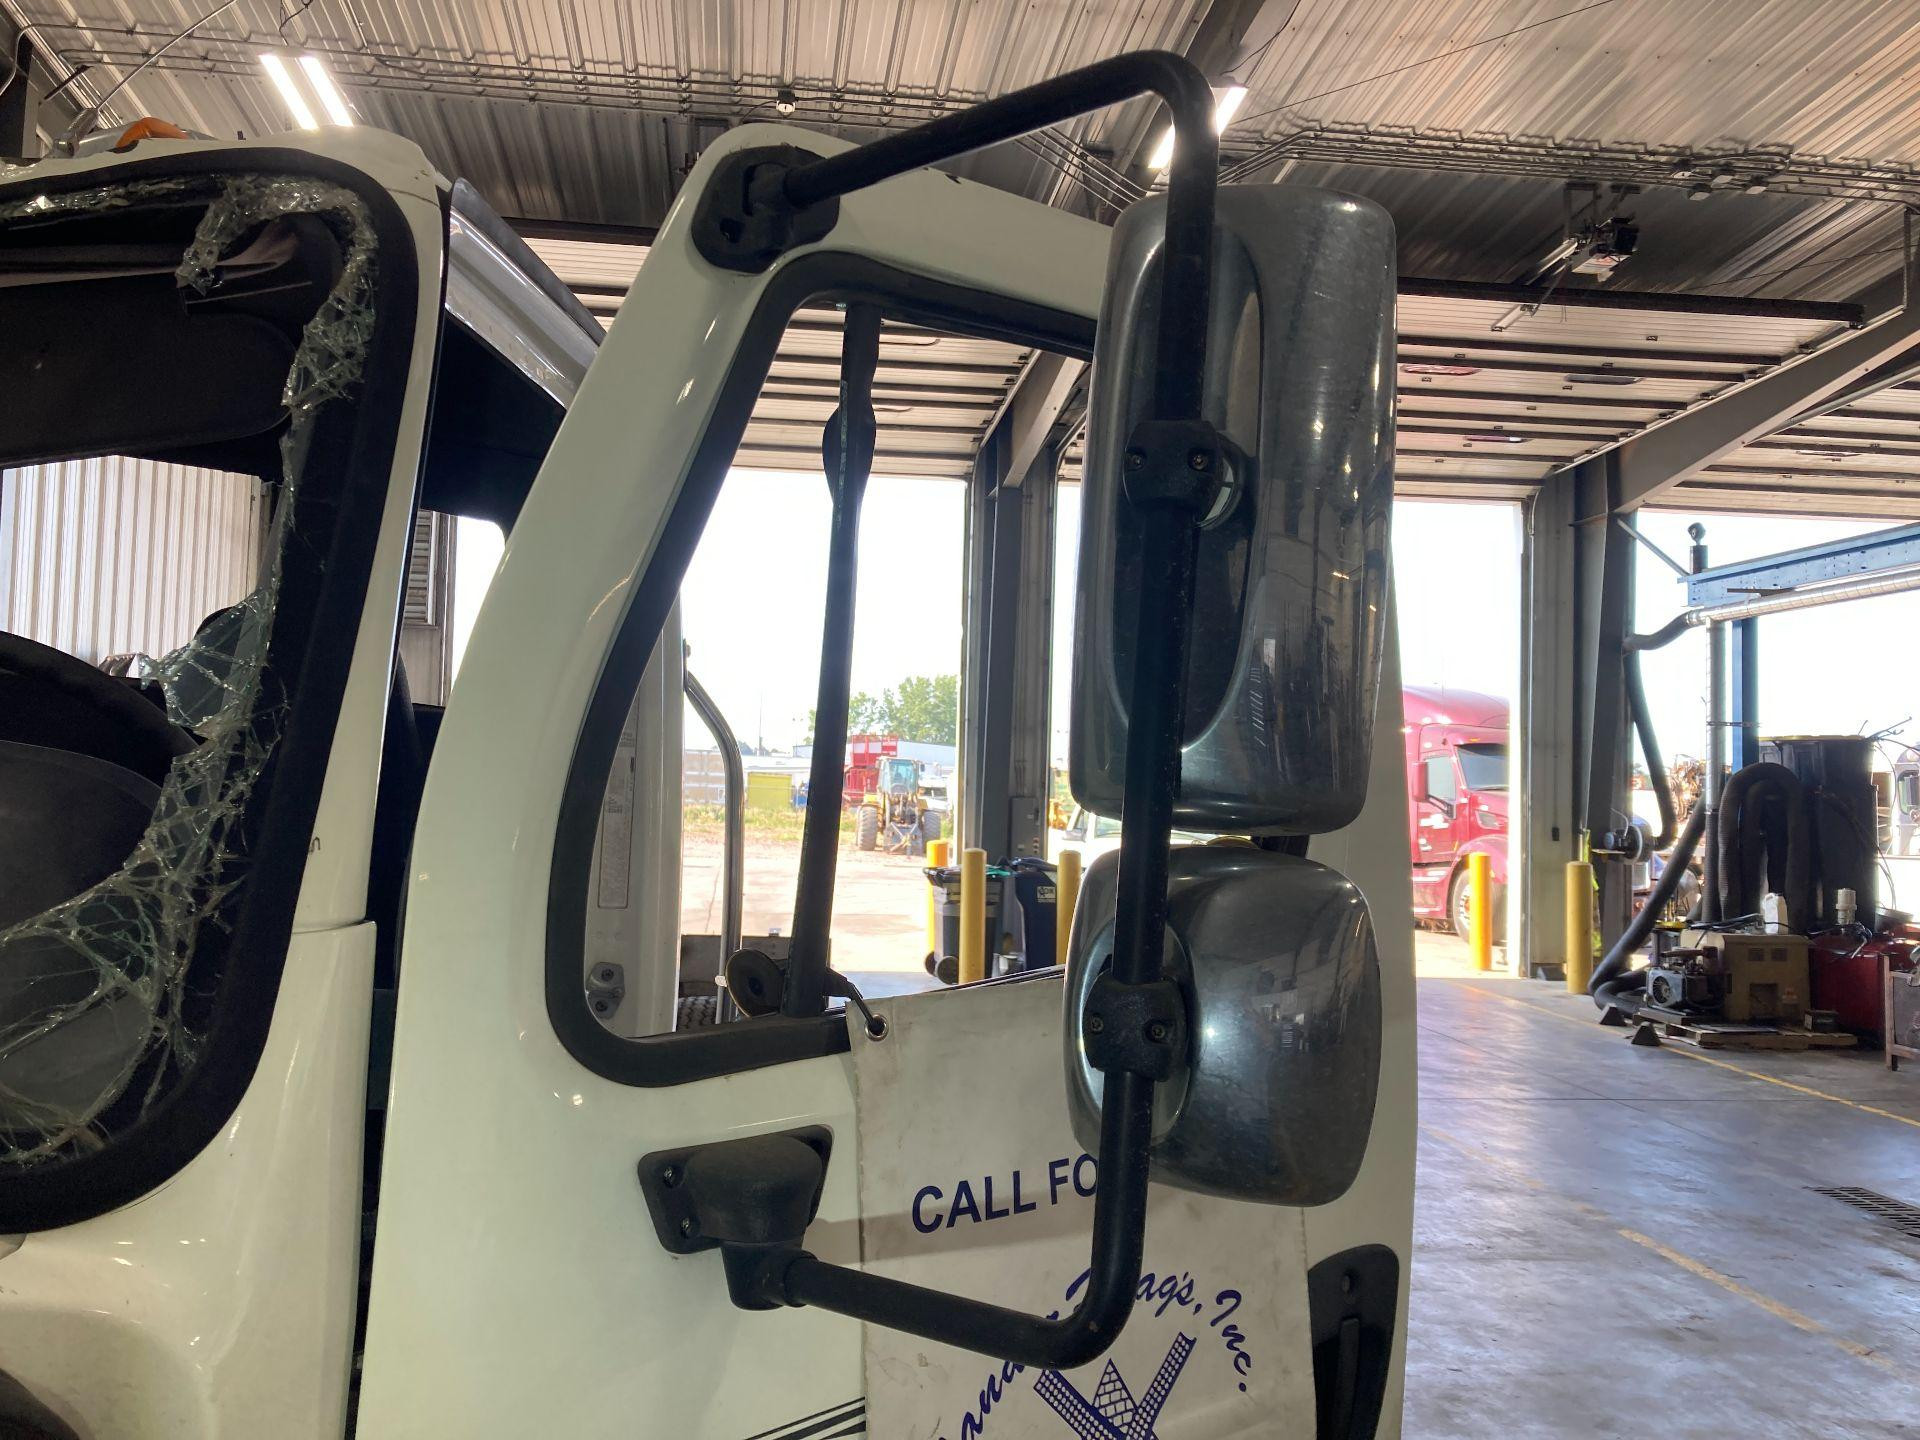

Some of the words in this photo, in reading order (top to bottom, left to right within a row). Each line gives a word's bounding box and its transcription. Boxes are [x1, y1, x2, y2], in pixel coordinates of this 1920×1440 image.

[912, 1170, 1036, 1233] CALL
[1048, 1153, 1098, 1205] FO
[1210, 1289, 1252, 1392] Inc.
